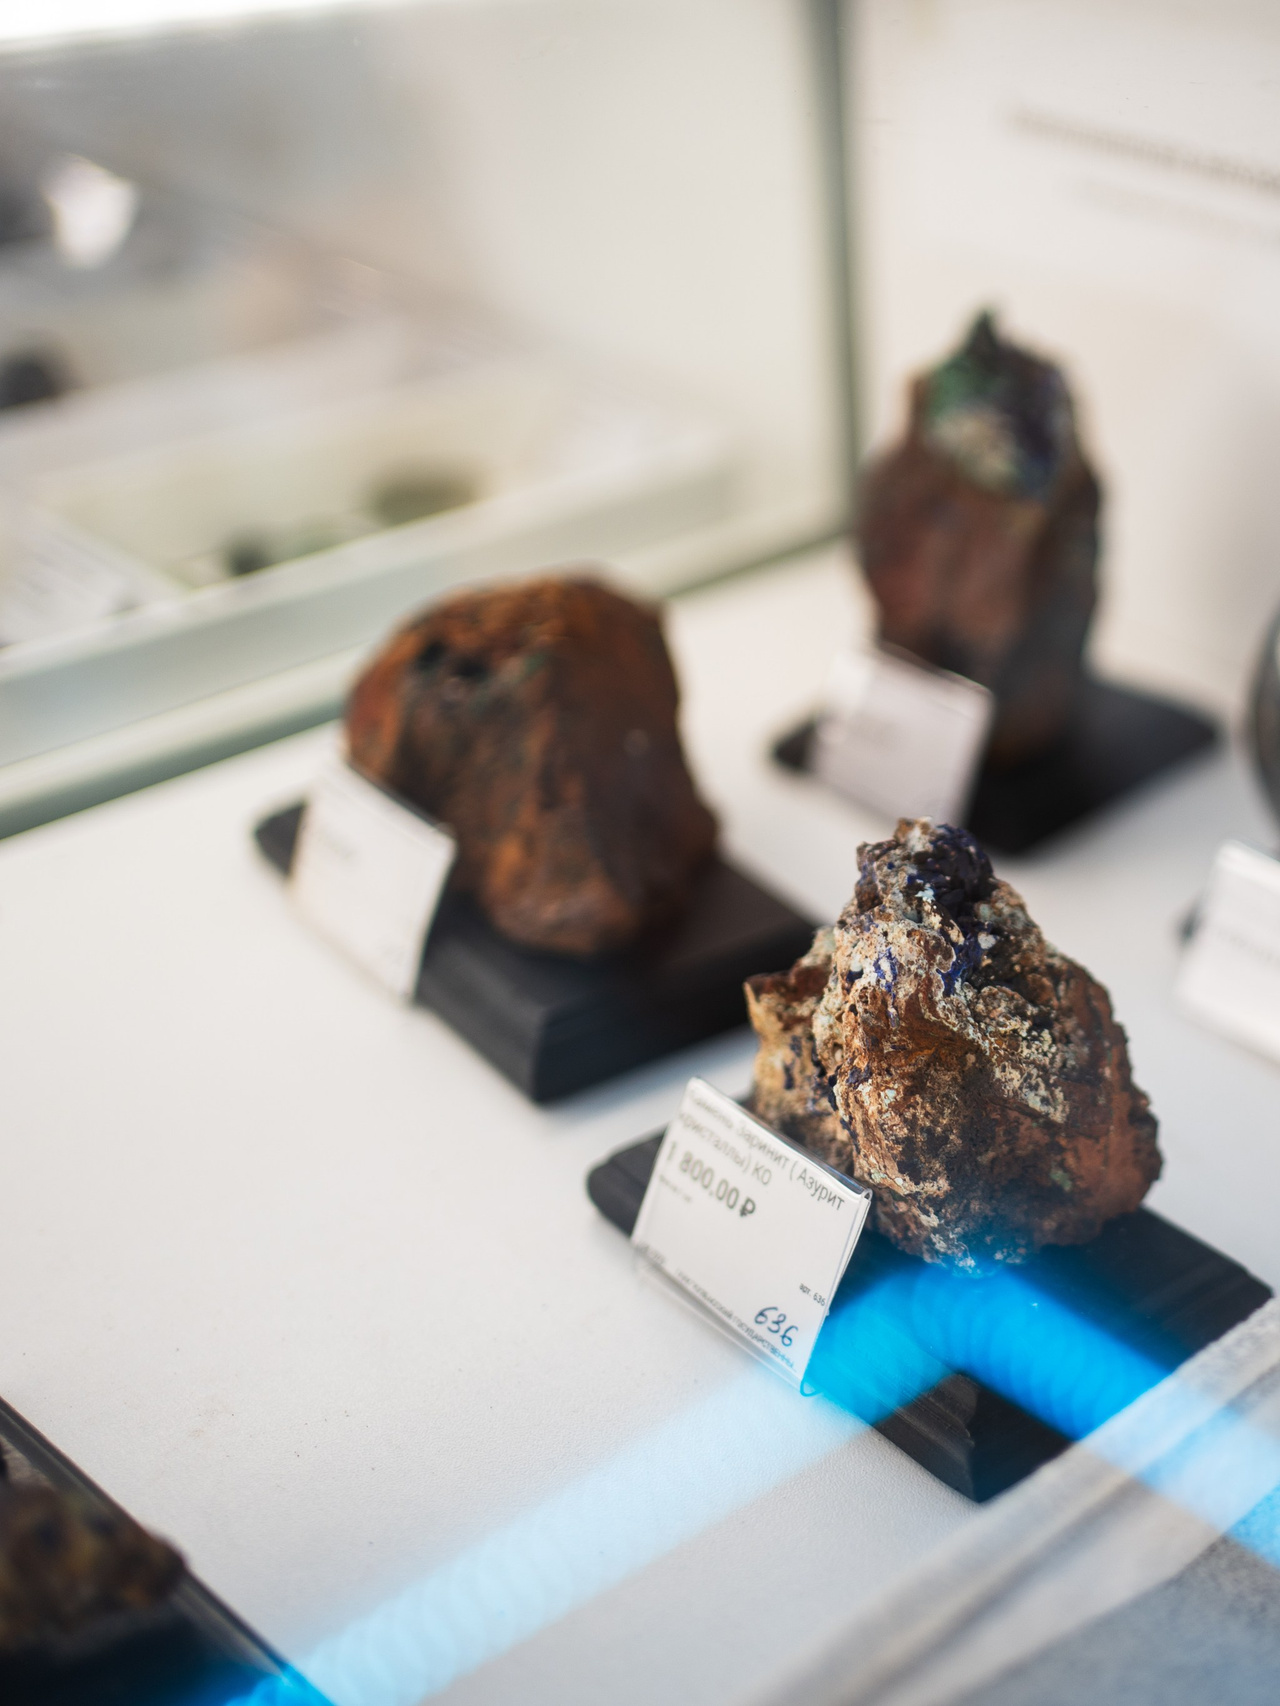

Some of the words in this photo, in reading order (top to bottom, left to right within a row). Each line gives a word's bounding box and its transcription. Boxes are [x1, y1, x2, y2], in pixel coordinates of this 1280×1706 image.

[752, 1161, 772, 1185] КО
[797, 1168, 845, 1210] Азурит
[813, 1292, 826, 1307] 636
[754, 1306, 799, 1347] 636
